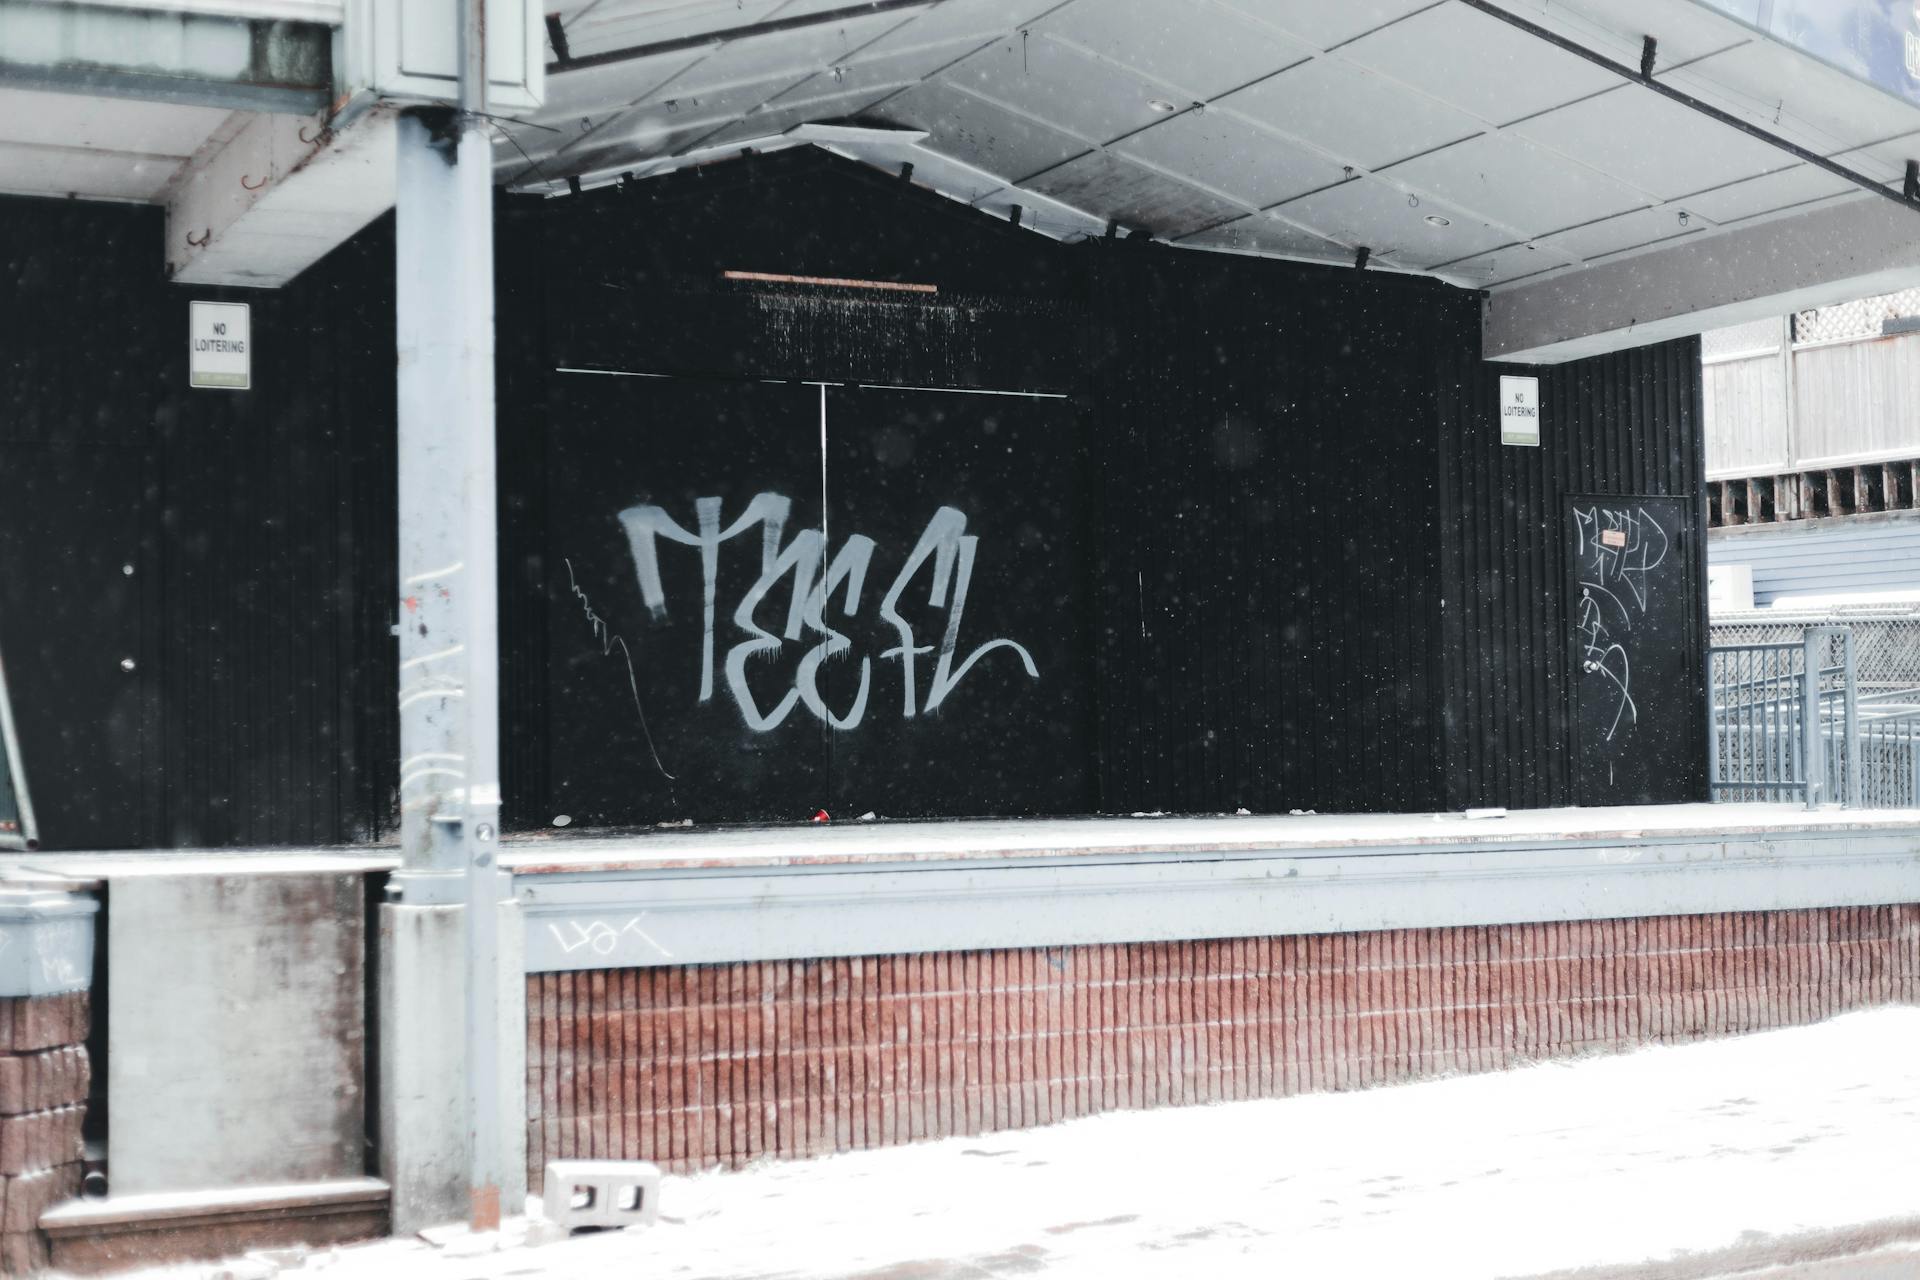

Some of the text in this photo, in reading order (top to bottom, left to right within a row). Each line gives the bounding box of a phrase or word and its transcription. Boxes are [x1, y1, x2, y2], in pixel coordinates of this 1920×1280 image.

[213, 322, 226, 336] NO
[195, 339, 244, 352] LOITERING
[1515, 392, 1524, 404] NO
[1504, 406, 1535, 417] LOITERING
